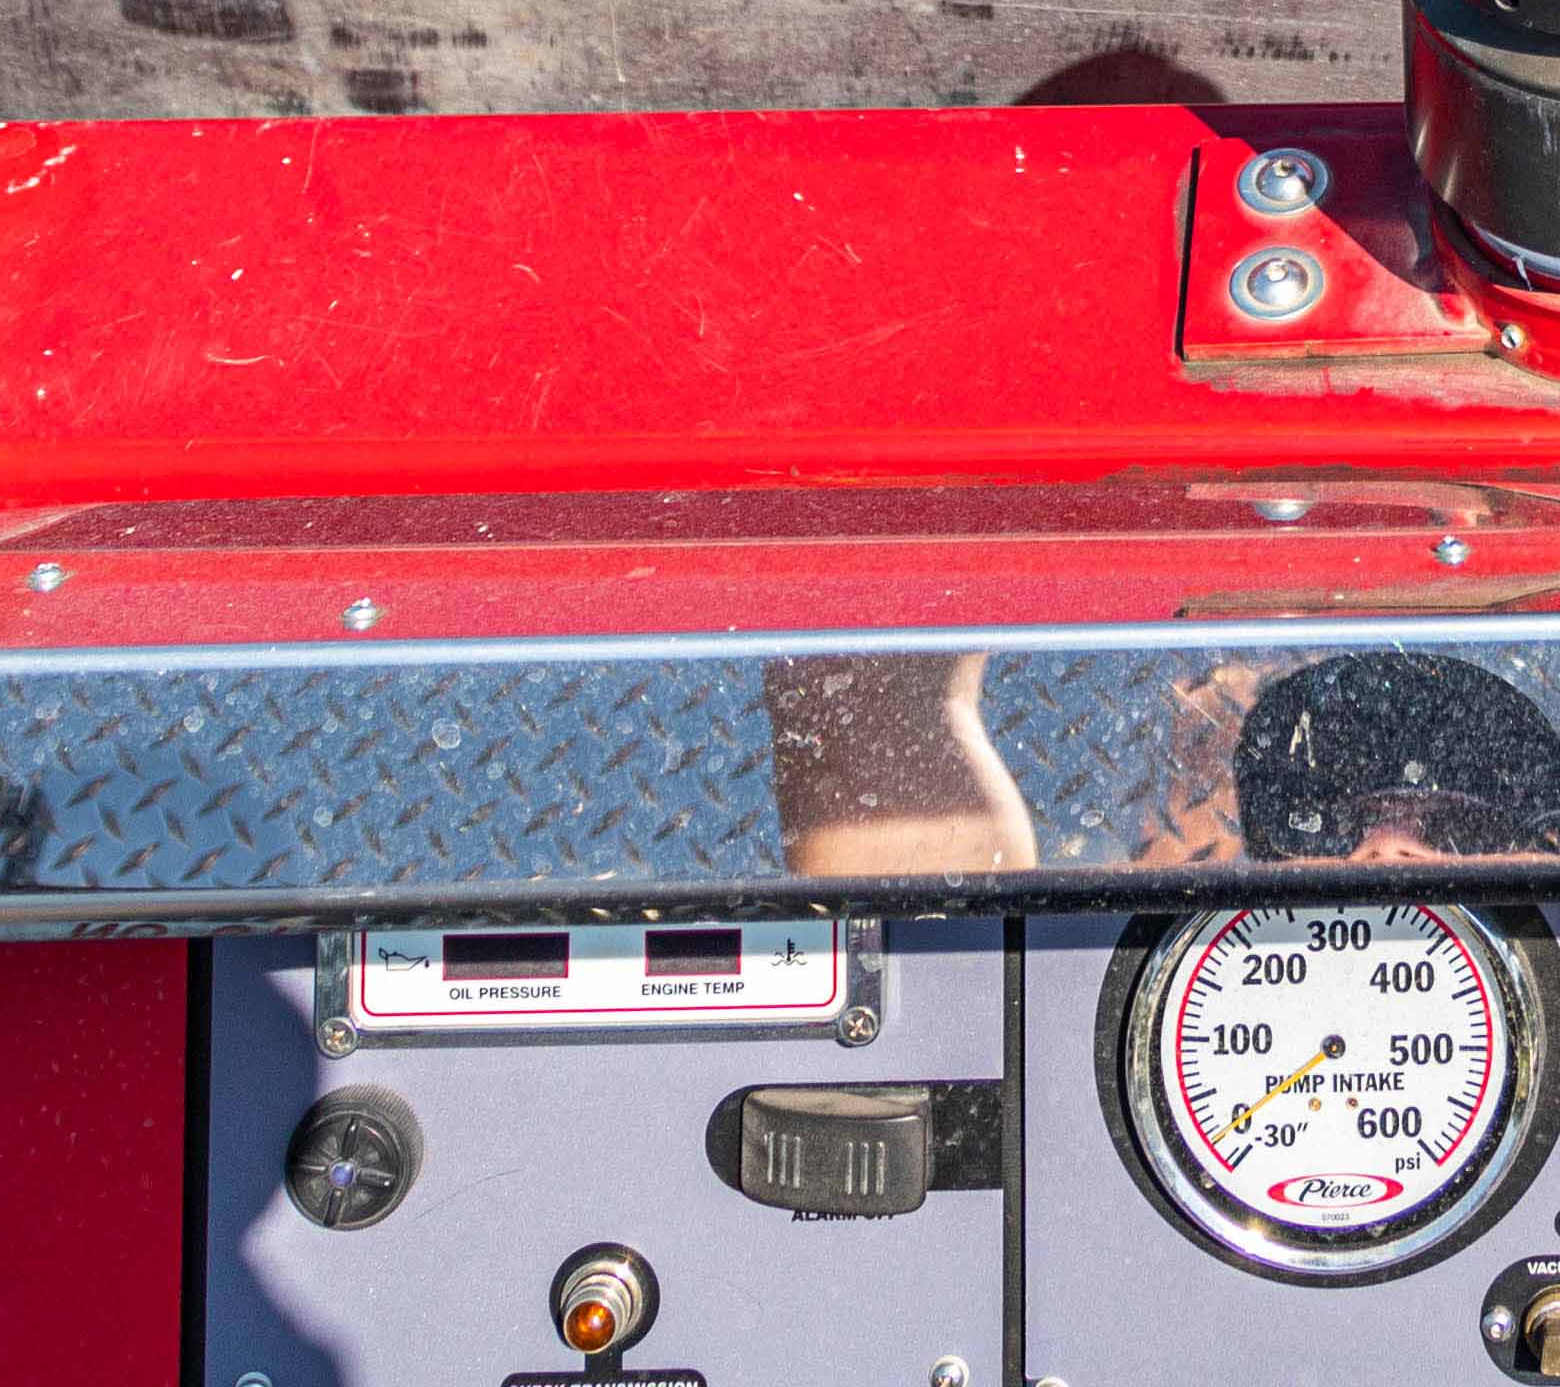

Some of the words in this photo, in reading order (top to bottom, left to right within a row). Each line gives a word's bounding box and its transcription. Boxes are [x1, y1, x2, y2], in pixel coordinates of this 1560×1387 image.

[1306, 919, 1371, 952] 300
[1242, 953, 1306, 985] 200
[1370, 961, 1435, 993] 400
[449, 987, 473, 1000] OIL
[479, 986, 561, 999] PRESSURE
[641, 983, 697, 996] ENGINE
[705, 982, 745, 994] TEMP
[1213, 1023, 1273, 1055] 100
[1389, 1033, 1454, 1066] 500
[1265, 1075, 1325, 1094] PUMP
[1333, 1072, 1405, 1092] INTAKE
[1232, 1103, 1252, 1134] 0
[1357, 1106, 1422, 1138] 600
[1395, 1152, 1421, 1173] psi
[1299, 1178, 1373, 1202] Pierce
